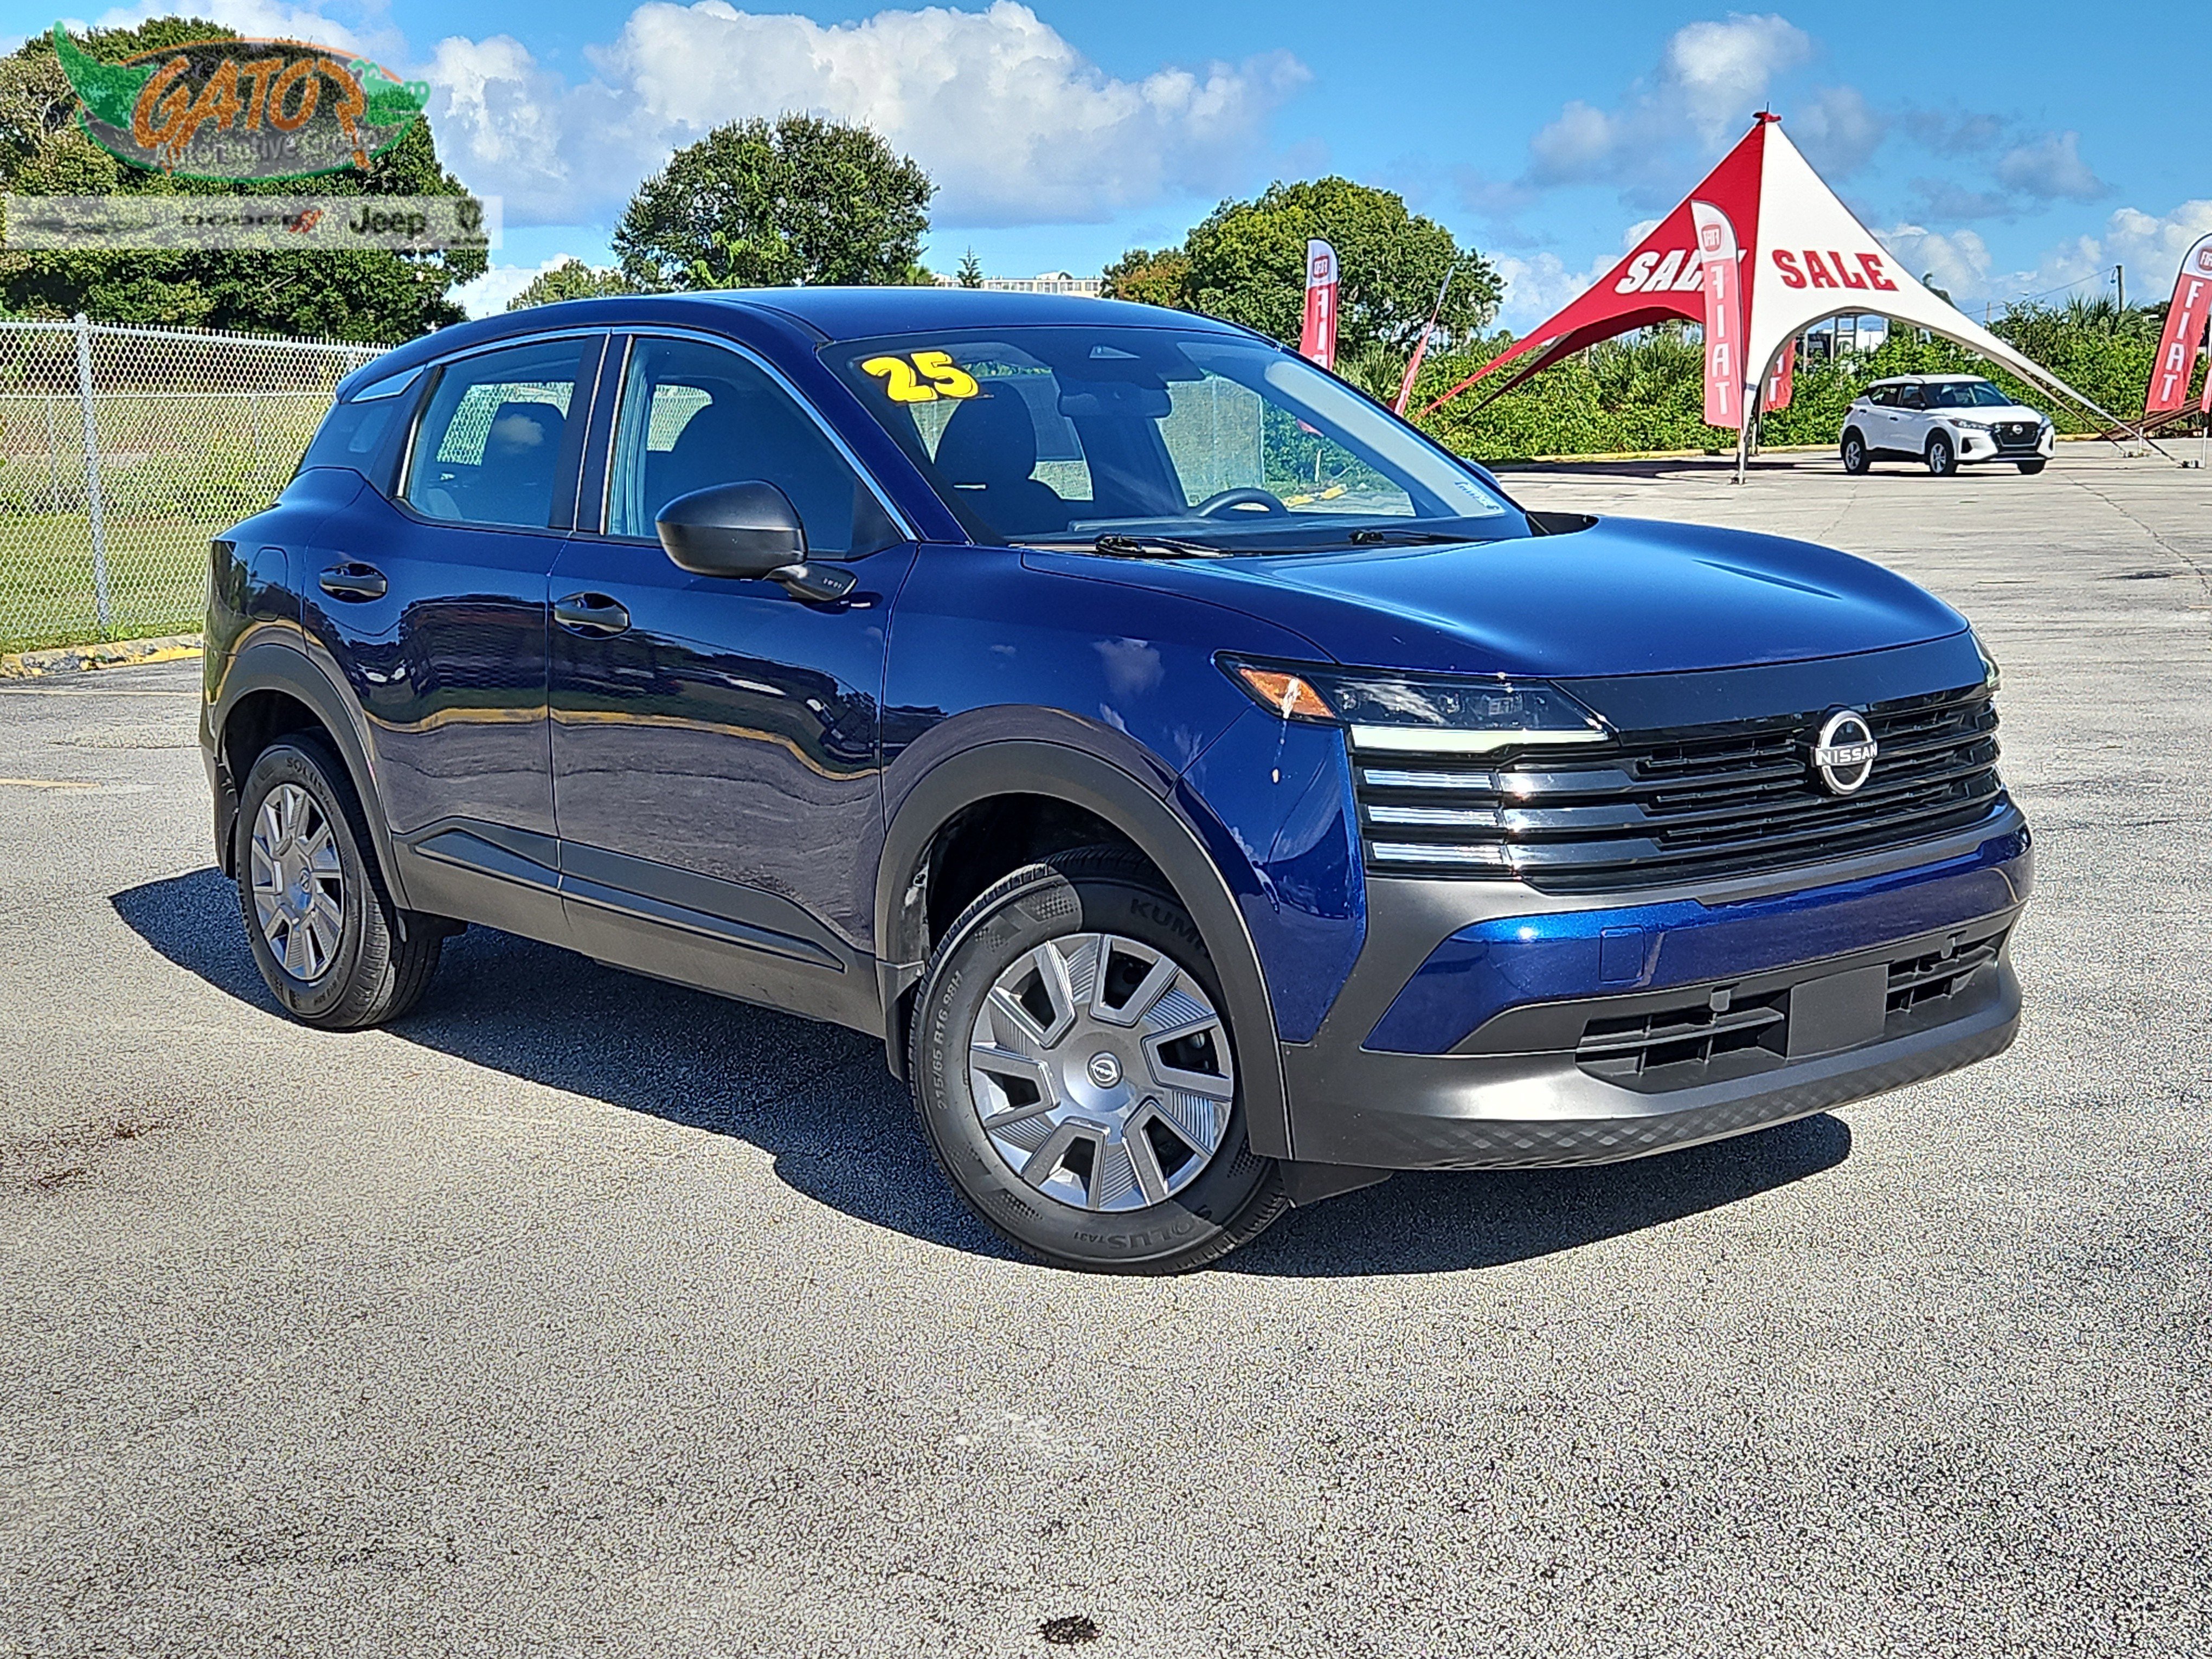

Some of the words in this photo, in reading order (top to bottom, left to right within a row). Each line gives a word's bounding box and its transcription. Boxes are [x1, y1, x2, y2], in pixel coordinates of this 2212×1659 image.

[1615, 249, 1747, 294] SAL
[1771, 249, 1899, 292] SALE
[2160, 281, 2204, 402] FIAT
[861, 351, 979, 402] 25
[1817, 744, 1877, 764] NISSAN
[1130, 898, 1211, 959] KUM
[942, 969, 963, 1006] 98H
[934, 1008, 949, 1045] R16
[933, 1048, 949, 1110] 215/65
[1107, 1204, 1212, 1250] SOLUS
